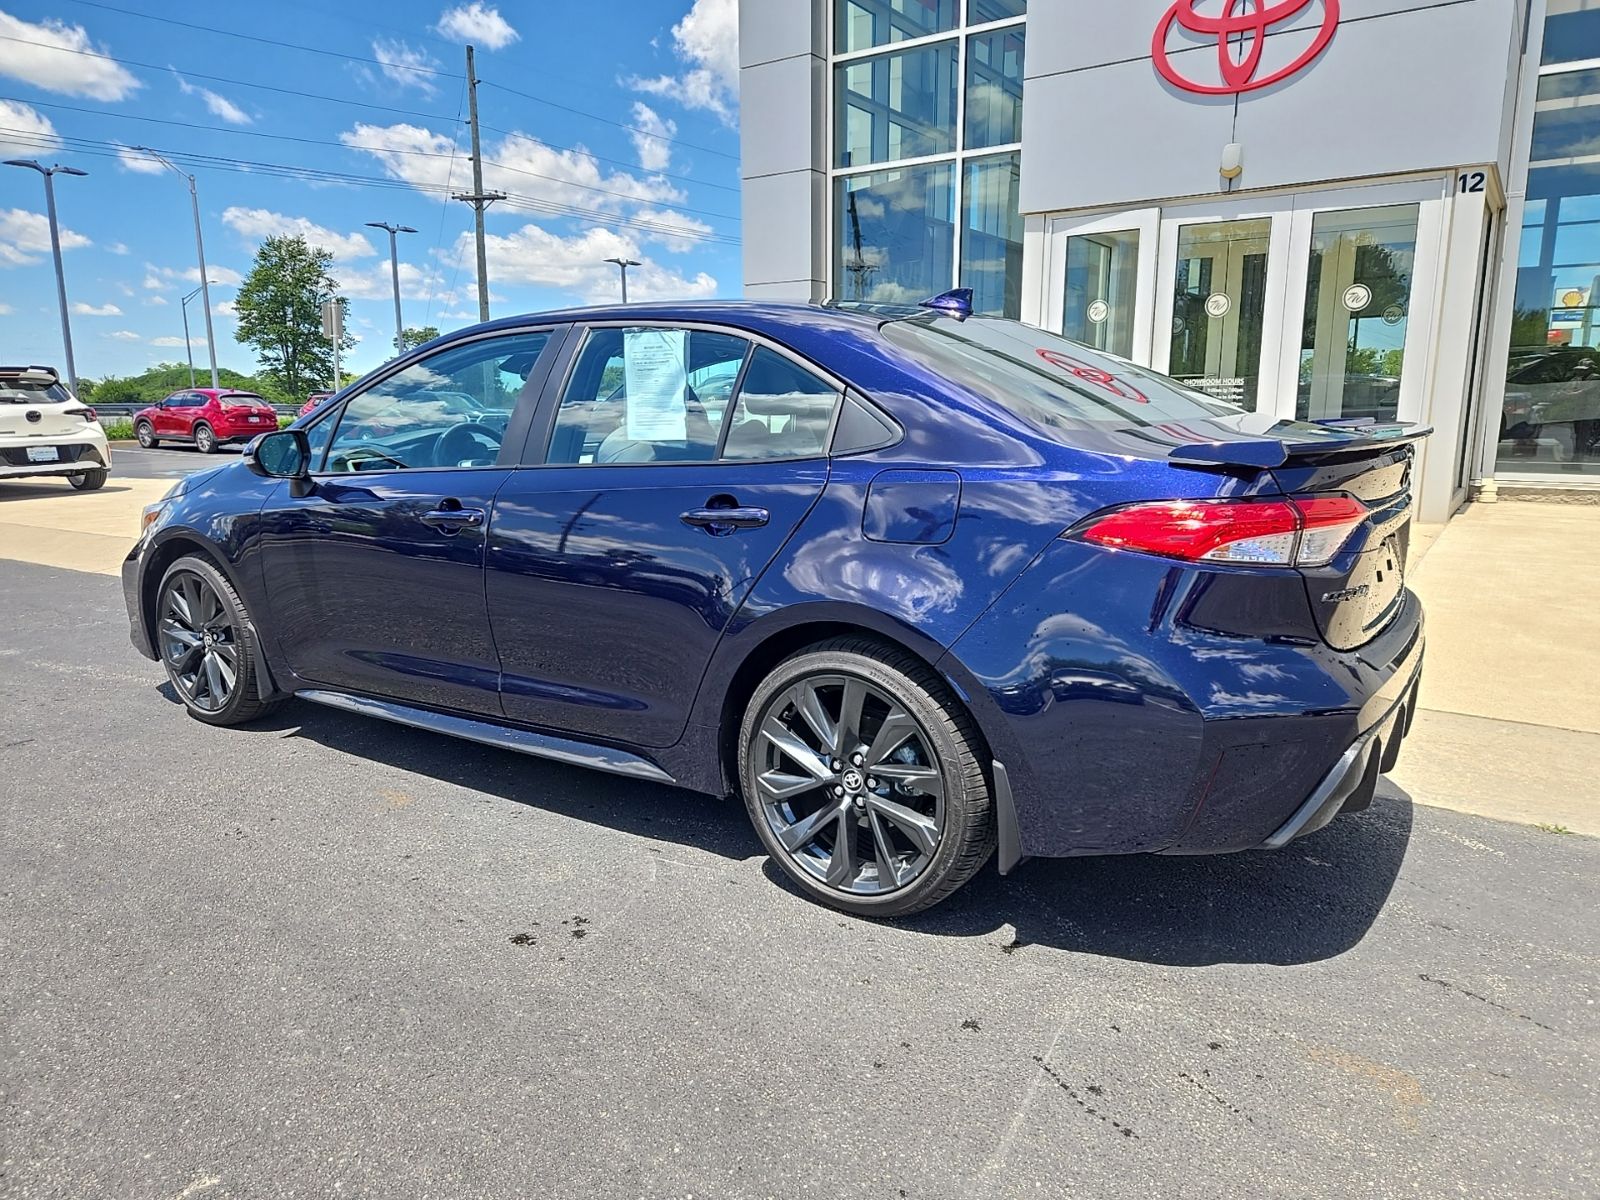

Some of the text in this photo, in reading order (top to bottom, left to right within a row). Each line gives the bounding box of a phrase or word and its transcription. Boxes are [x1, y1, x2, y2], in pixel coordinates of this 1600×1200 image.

[1459, 172, 1485, 194] 12
[1183, 377, 1245, 386] SHOWROOM HOURS
